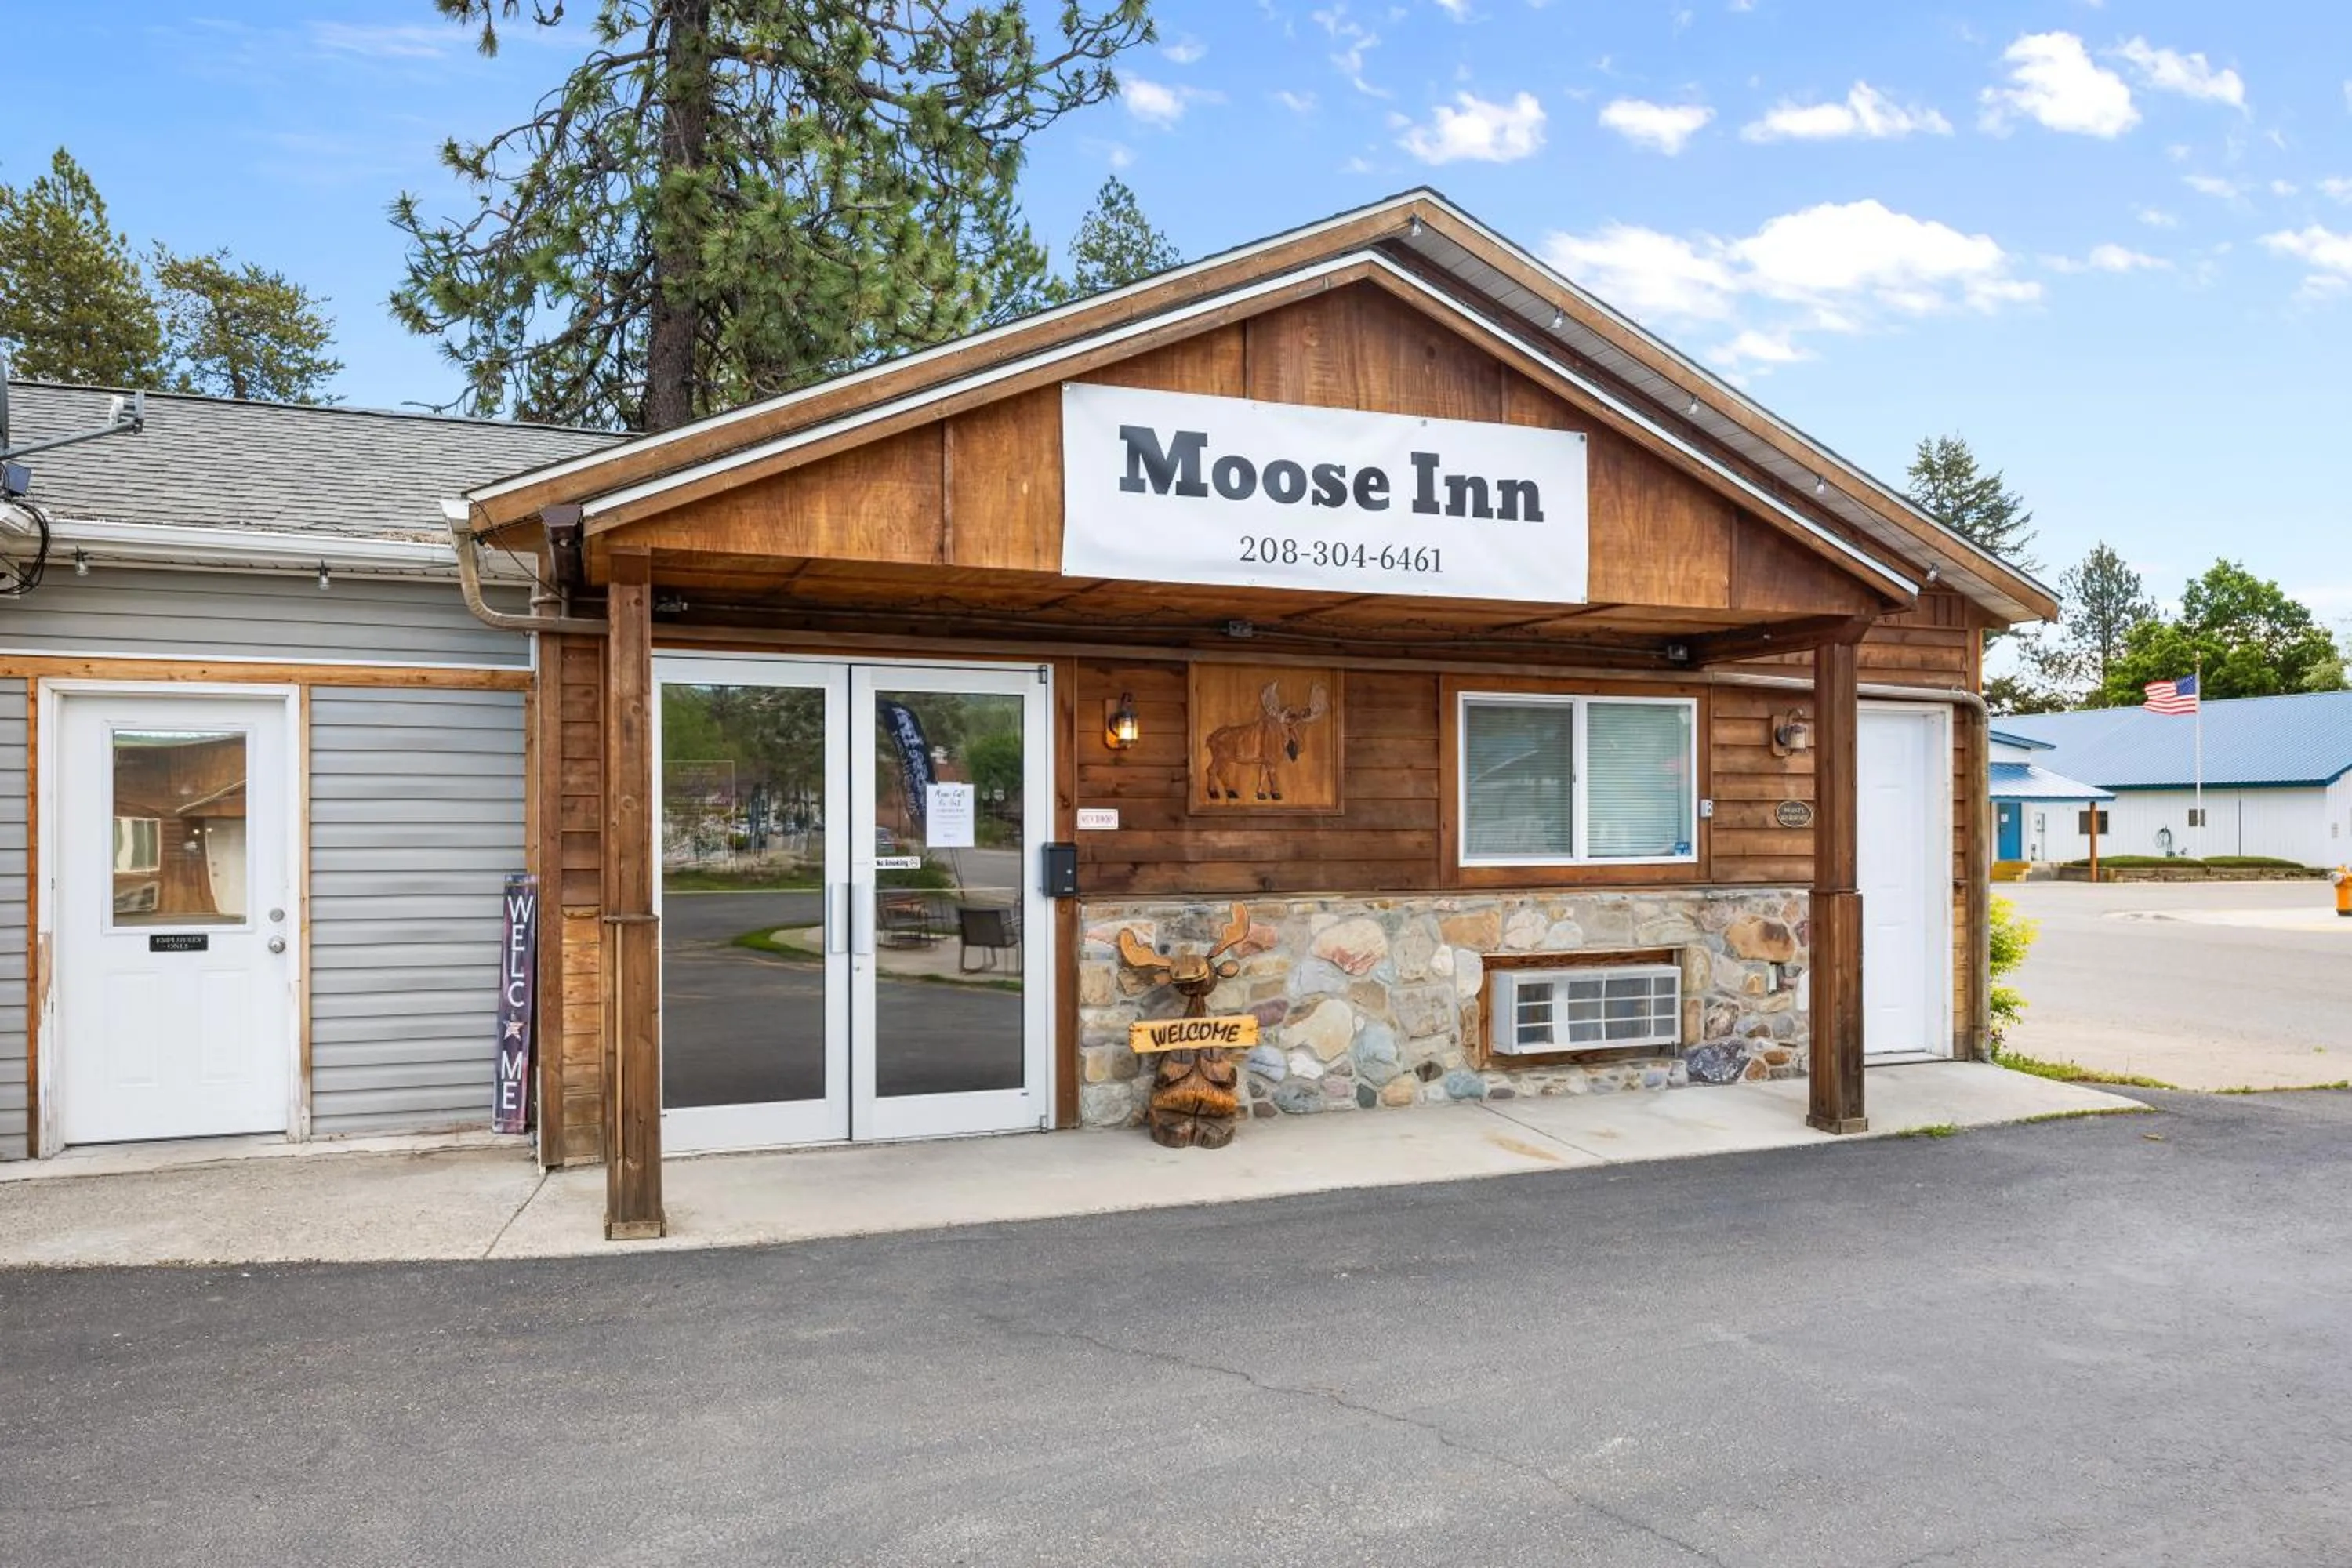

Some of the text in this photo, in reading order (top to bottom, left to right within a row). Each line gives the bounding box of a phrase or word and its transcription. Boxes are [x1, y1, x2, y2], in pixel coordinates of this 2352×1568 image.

[1119, 424, 1545, 523] Moose Inn
[1239, 535, 1444, 573] 208-304-6461
[1151, 1022, 1241, 1047] WELCOME
